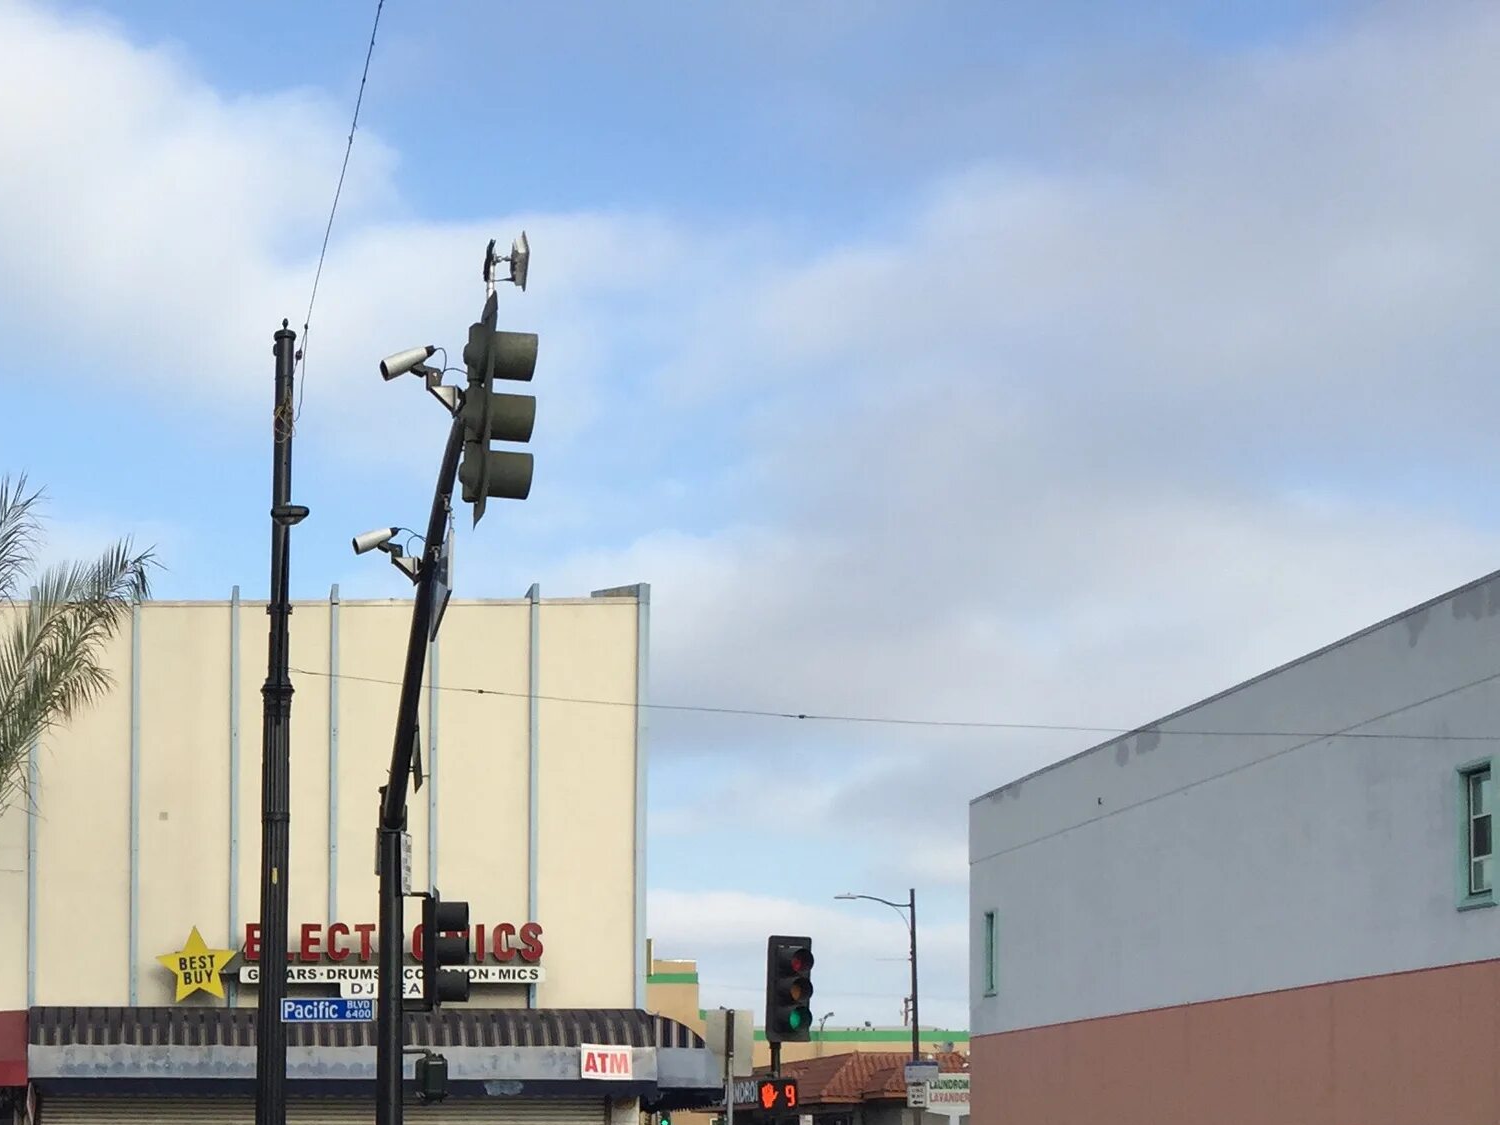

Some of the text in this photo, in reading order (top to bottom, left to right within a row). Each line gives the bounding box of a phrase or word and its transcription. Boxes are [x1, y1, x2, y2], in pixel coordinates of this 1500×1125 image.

[244, 922, 544, 962] EECTICS
[178, 954, 215, 971] BEST
[183, 969, 213, 986] BUY
[247, 968, 317, 980] GARS
[499, 968, 539, 980] MICS
[284, 1001, 370, 1018] Pacific BLVD
[345, 1010, 371, 1018] 6400
[585, 1051, 629, 1074] ATM
[785, 1084, 796, 1107] 9
